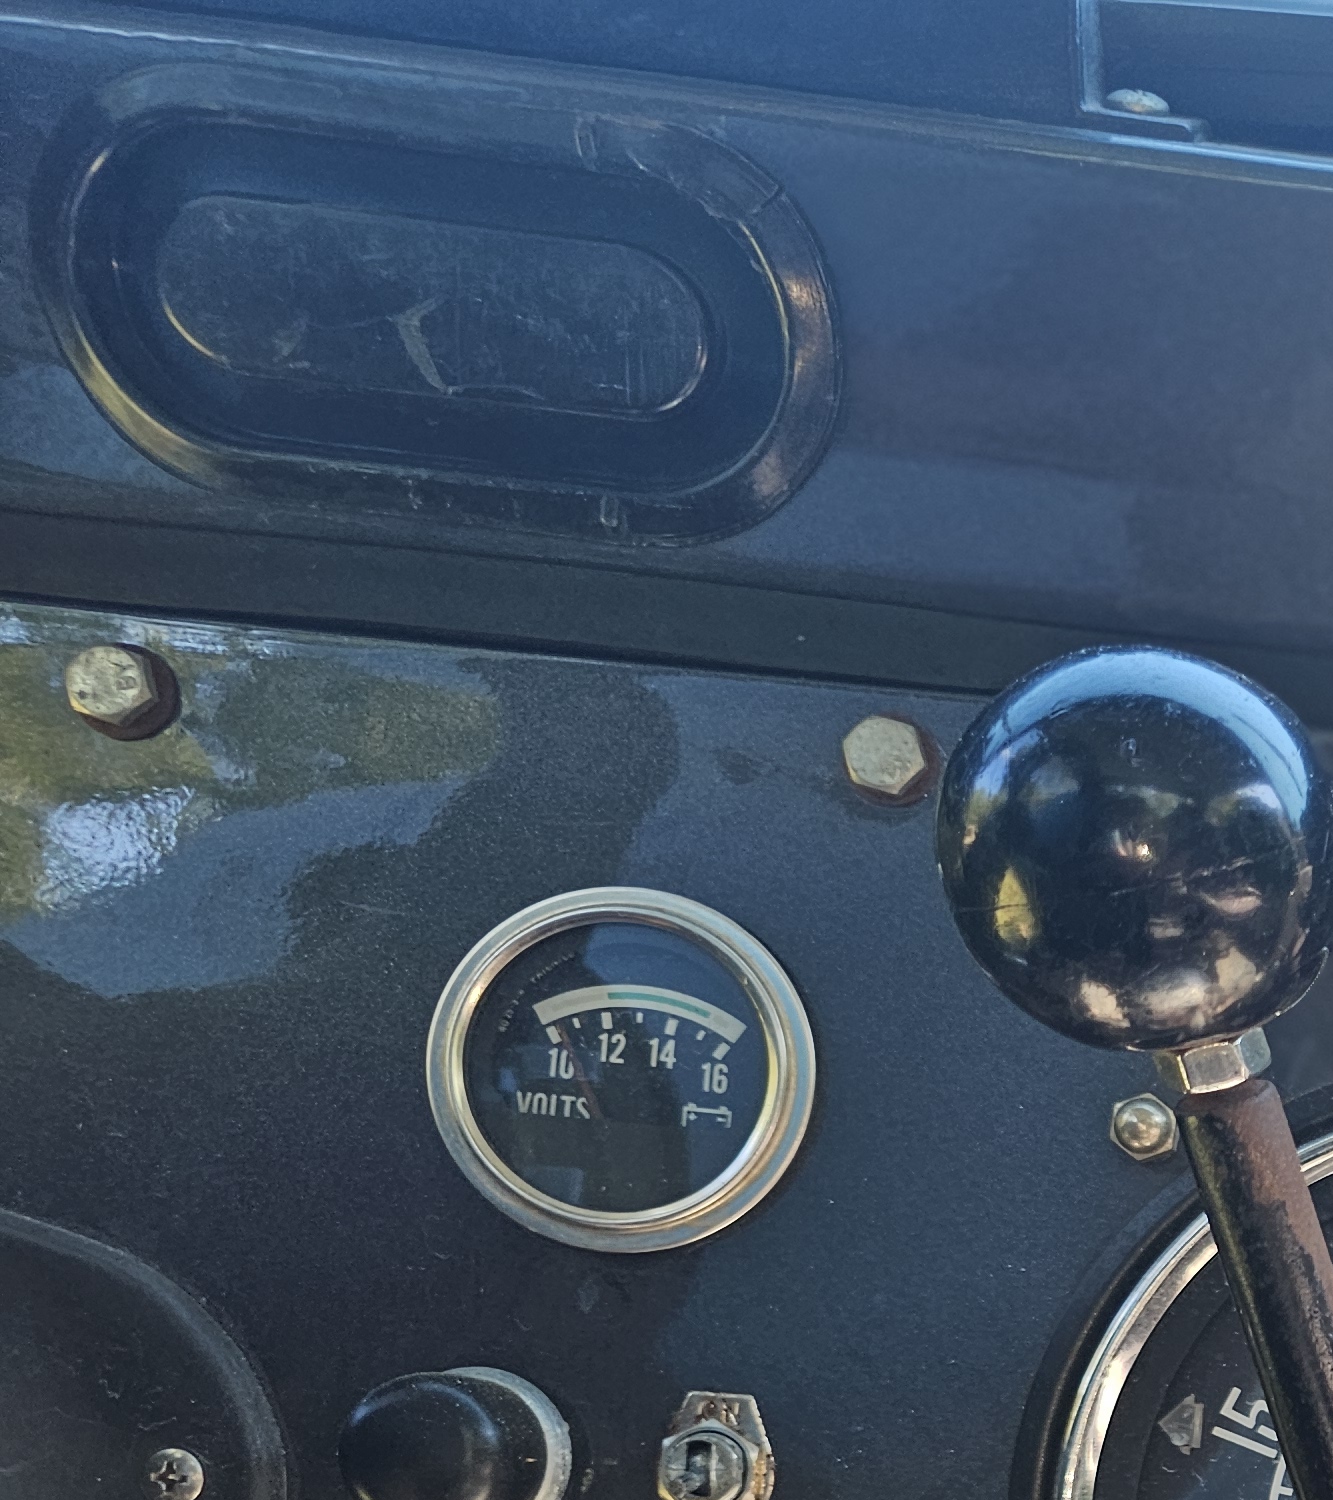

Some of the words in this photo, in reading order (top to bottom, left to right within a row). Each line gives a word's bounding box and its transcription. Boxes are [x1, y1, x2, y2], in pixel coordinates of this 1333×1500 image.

[548, 1047, 575, 1080] 10
[598, 1033, 627, 1064] 12
[649, 1037, 677, 1069] 14
[701, 1062, 729, 1094] 16
[1211, 1386, 1279, 1459] 15
